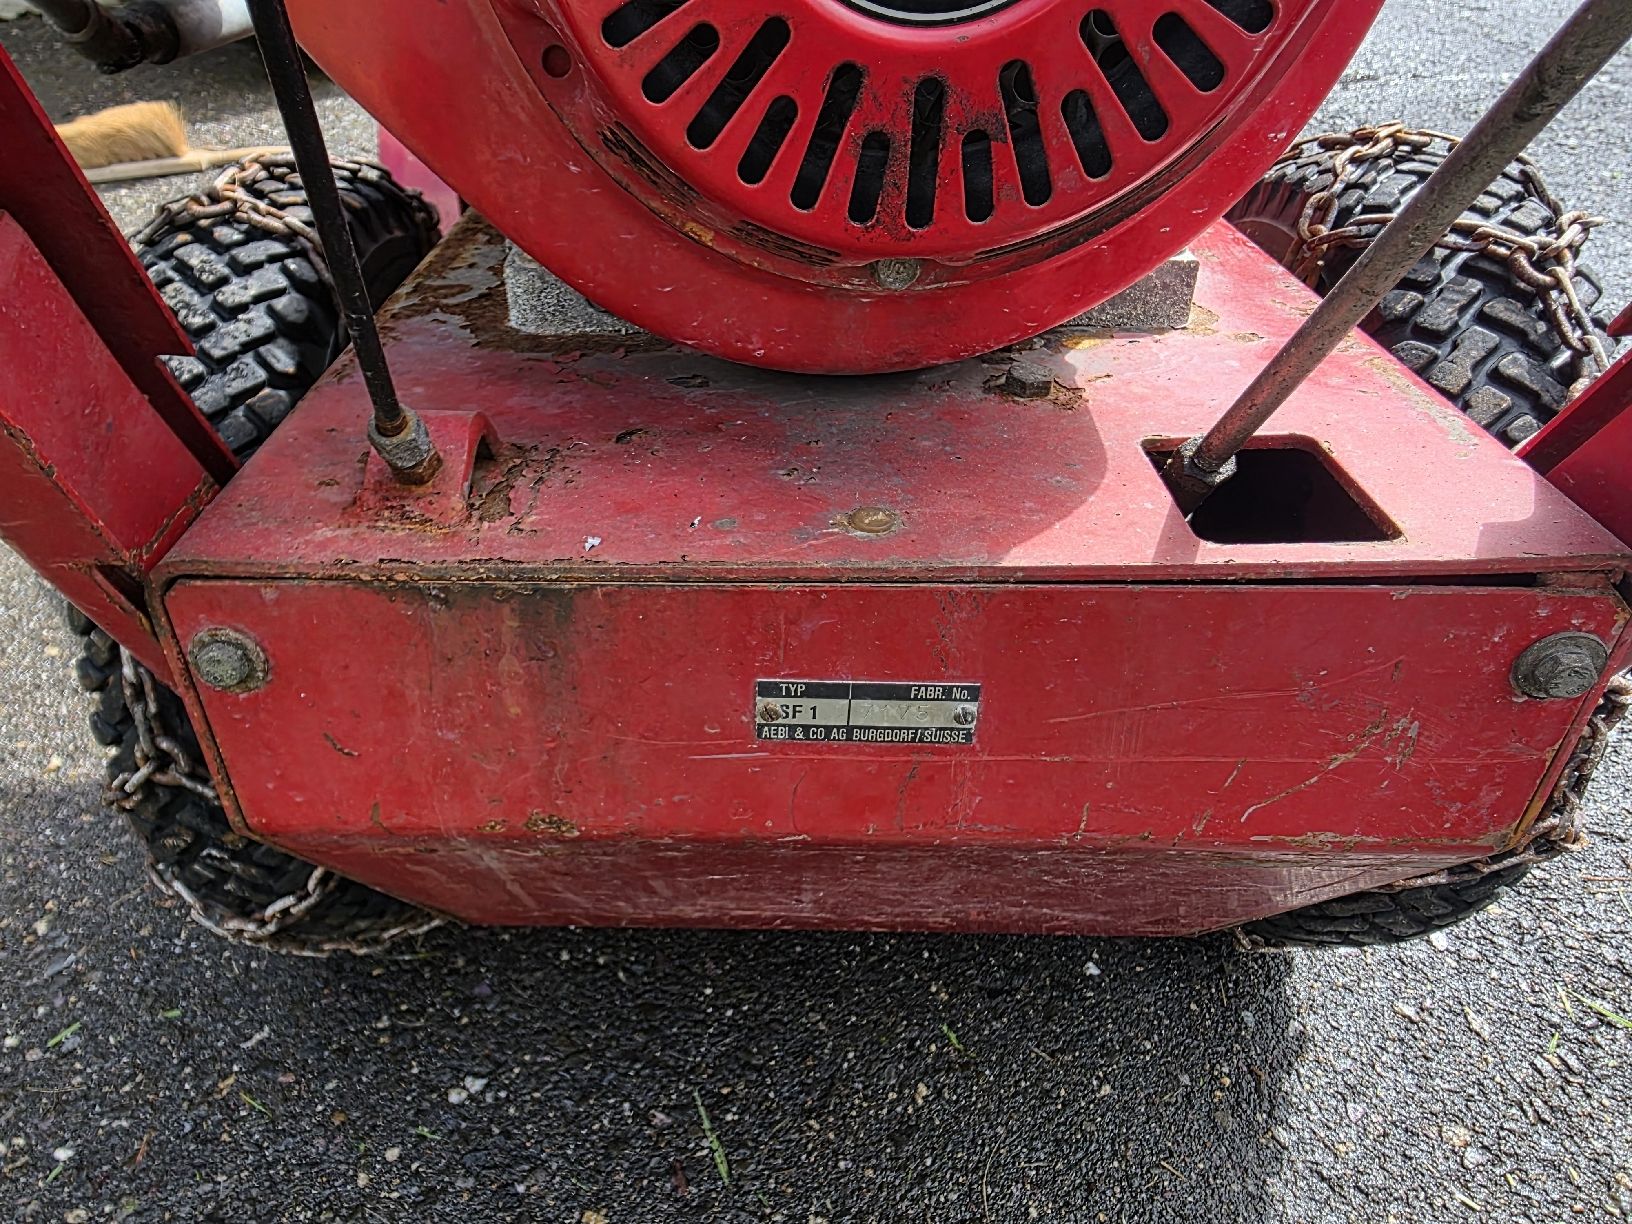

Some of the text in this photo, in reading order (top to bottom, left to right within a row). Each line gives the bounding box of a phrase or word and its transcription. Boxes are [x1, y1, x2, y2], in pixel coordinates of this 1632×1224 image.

[780, 683, 806, 696] TYP
[910, 686, 971, 700] FABR. No.
[780, 704, 818, 720] SF 1
[762, 726, 789, 739] AEBI
[794, 726, 804, 740] &
[830, 728, 847, 741] AG
